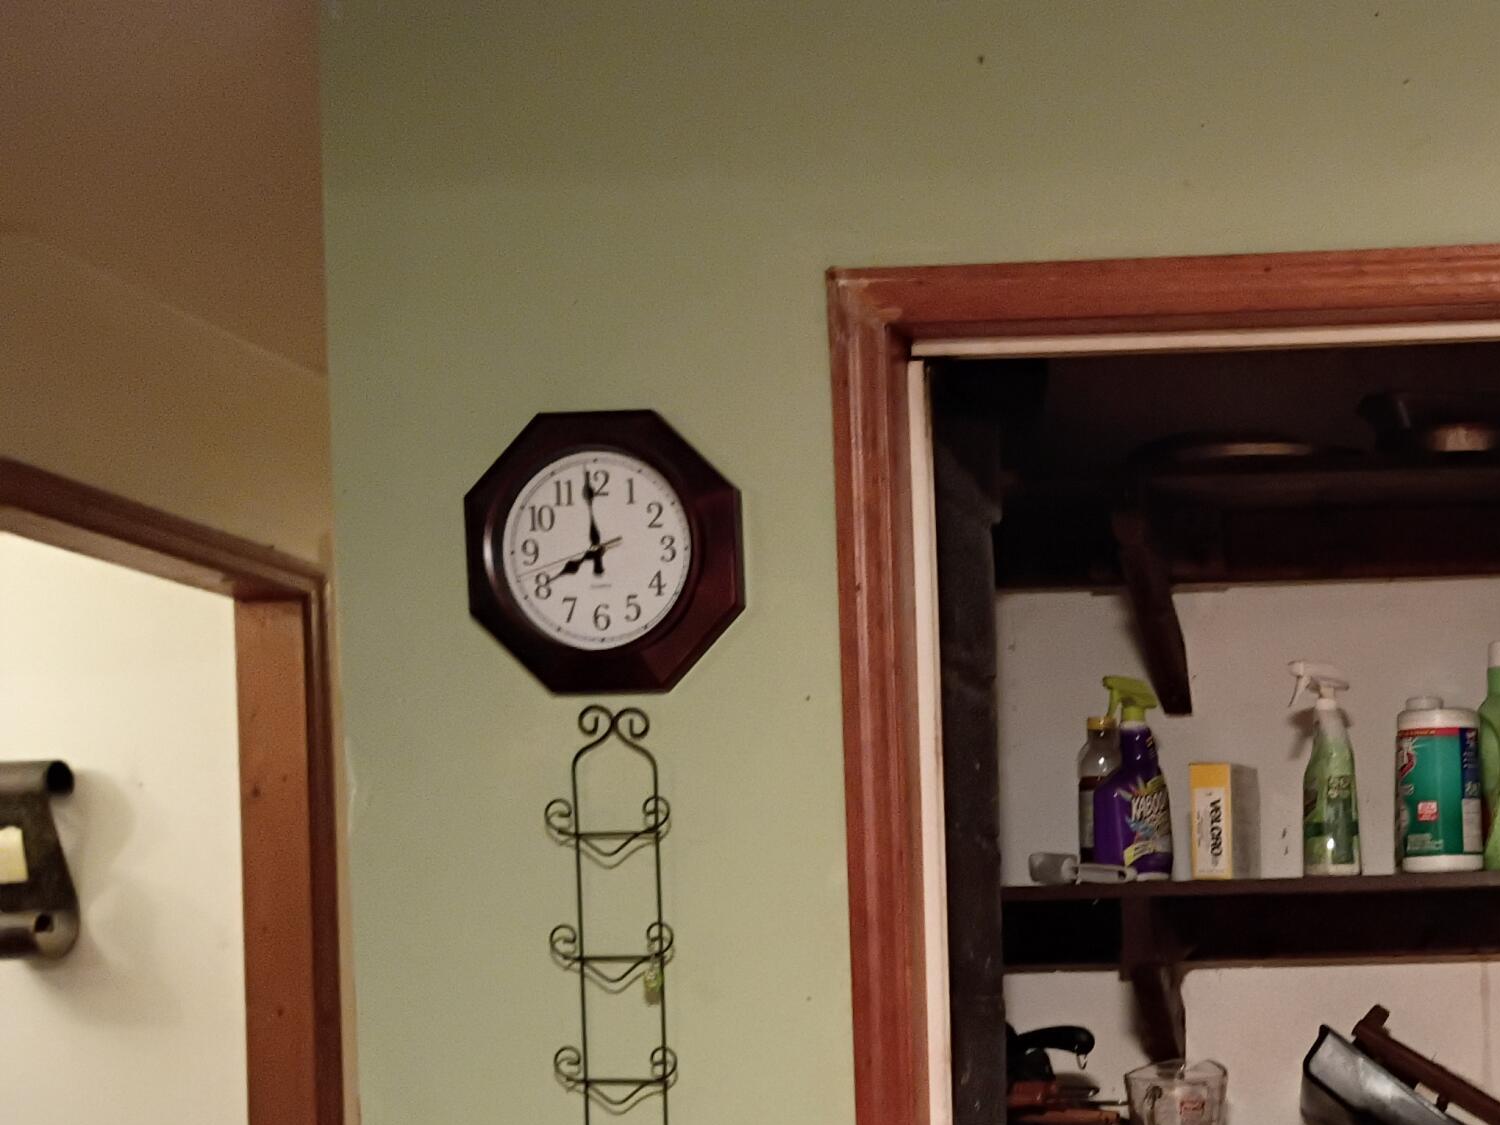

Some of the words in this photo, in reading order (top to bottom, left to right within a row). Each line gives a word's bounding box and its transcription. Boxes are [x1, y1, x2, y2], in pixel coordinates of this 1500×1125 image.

[554, 480, 573, 507] 11
[625, 478, 635, 505] 1
[529, 505, 556, 532] 10
[647, 502, 664, 529] 2
[521, 538, 540, 566] 9
[660, 535, 677, 563] 3
[534, 572, 552, 600] 8
[648, 570, 666, 597] 4
[562, 597, 578, 623] 7
[593, 604, 611, 631] 6
[624, 595, 642, 622] 5
[1209, 798, 1223, 857] VELCRO
